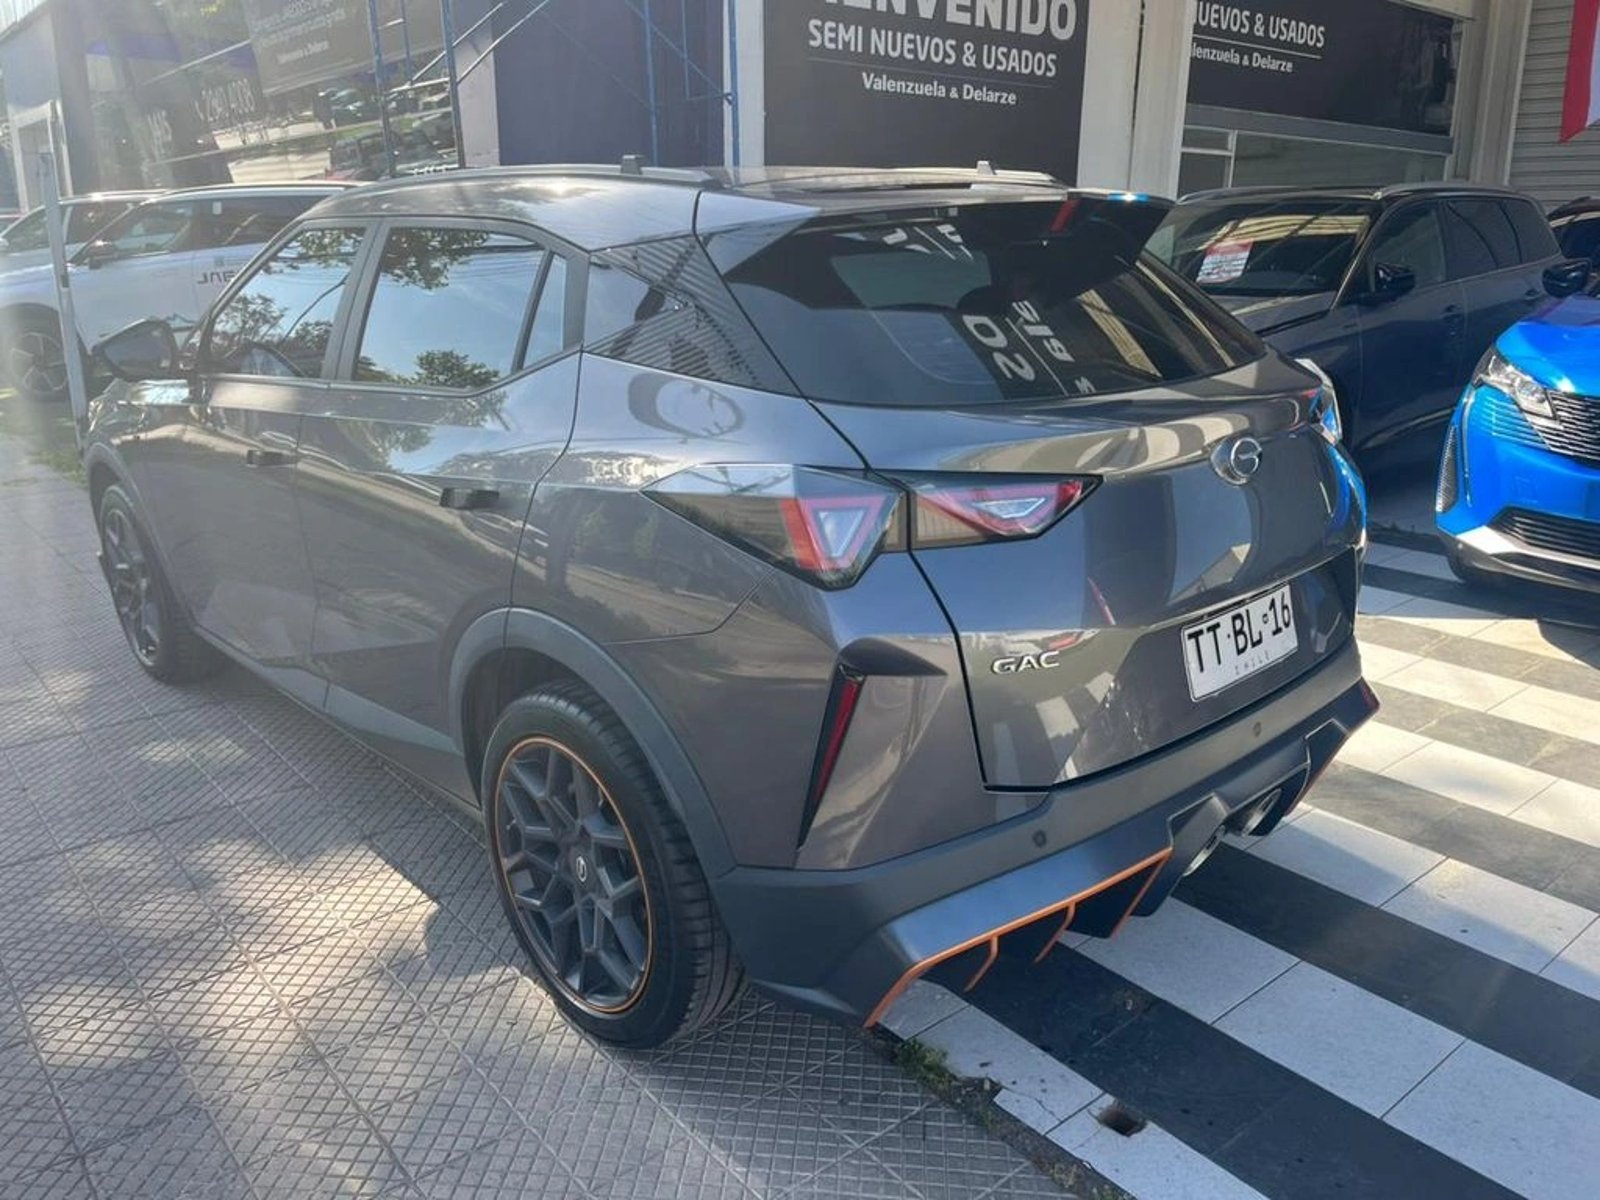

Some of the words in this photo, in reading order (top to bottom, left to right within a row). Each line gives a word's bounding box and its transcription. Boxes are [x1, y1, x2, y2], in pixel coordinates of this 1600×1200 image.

[1194, 2, 1250, 33] UEVOS
[1254, 13, 1265, 37] &
[1269, 15, 1325, 47] USADOS
[808, 19, 863, 54] SEMI
[870, 27, 956, 65] NUEVOS
[962, 41, 976, 68] &
[982, 44, 1057, 77] USADOS
[1192, 42, 1240, 66] lenzuela
[1242, 55, 1250, 67] &
[1252, 52, 1293, 73] Delarze
[862, 71, 946, 97] Valenzuela
[949, 87, 959, 99] &
[962, 84, 1017, 105] Delarze
[992, 650, 1060, 674] GAC
